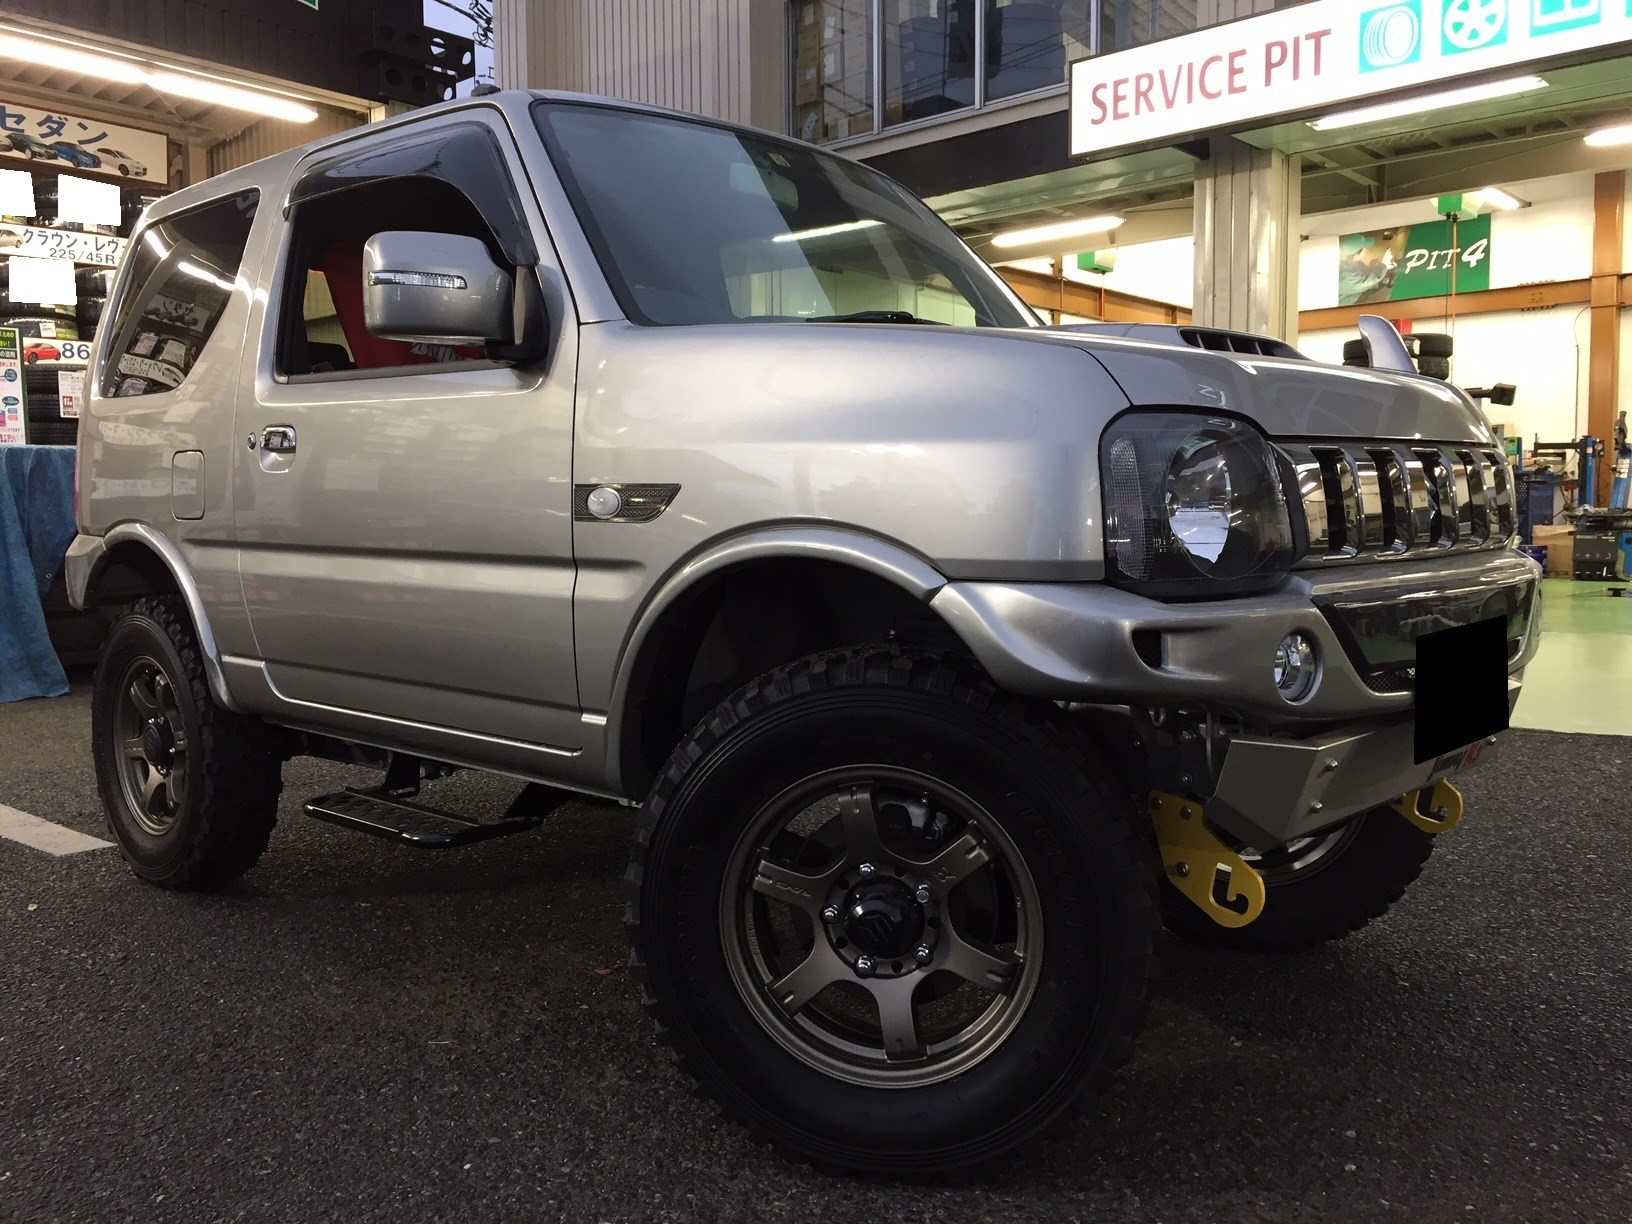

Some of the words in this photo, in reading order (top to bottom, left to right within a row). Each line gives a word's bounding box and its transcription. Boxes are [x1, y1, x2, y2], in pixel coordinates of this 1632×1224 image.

[1090, 48, 1247, 126] SERVICE
[1264, 28, 1332, 88] PIT
[0, 105, 109, 146] セダン
[22, 228, 126, 254] クラウン・レヴ
[49, 247, 116, 265] 225/45R
[1404, 248, 1461, 275] PIT
[1461, 238, 1488, 268] 4
[61, 342, 91, 360] 86
